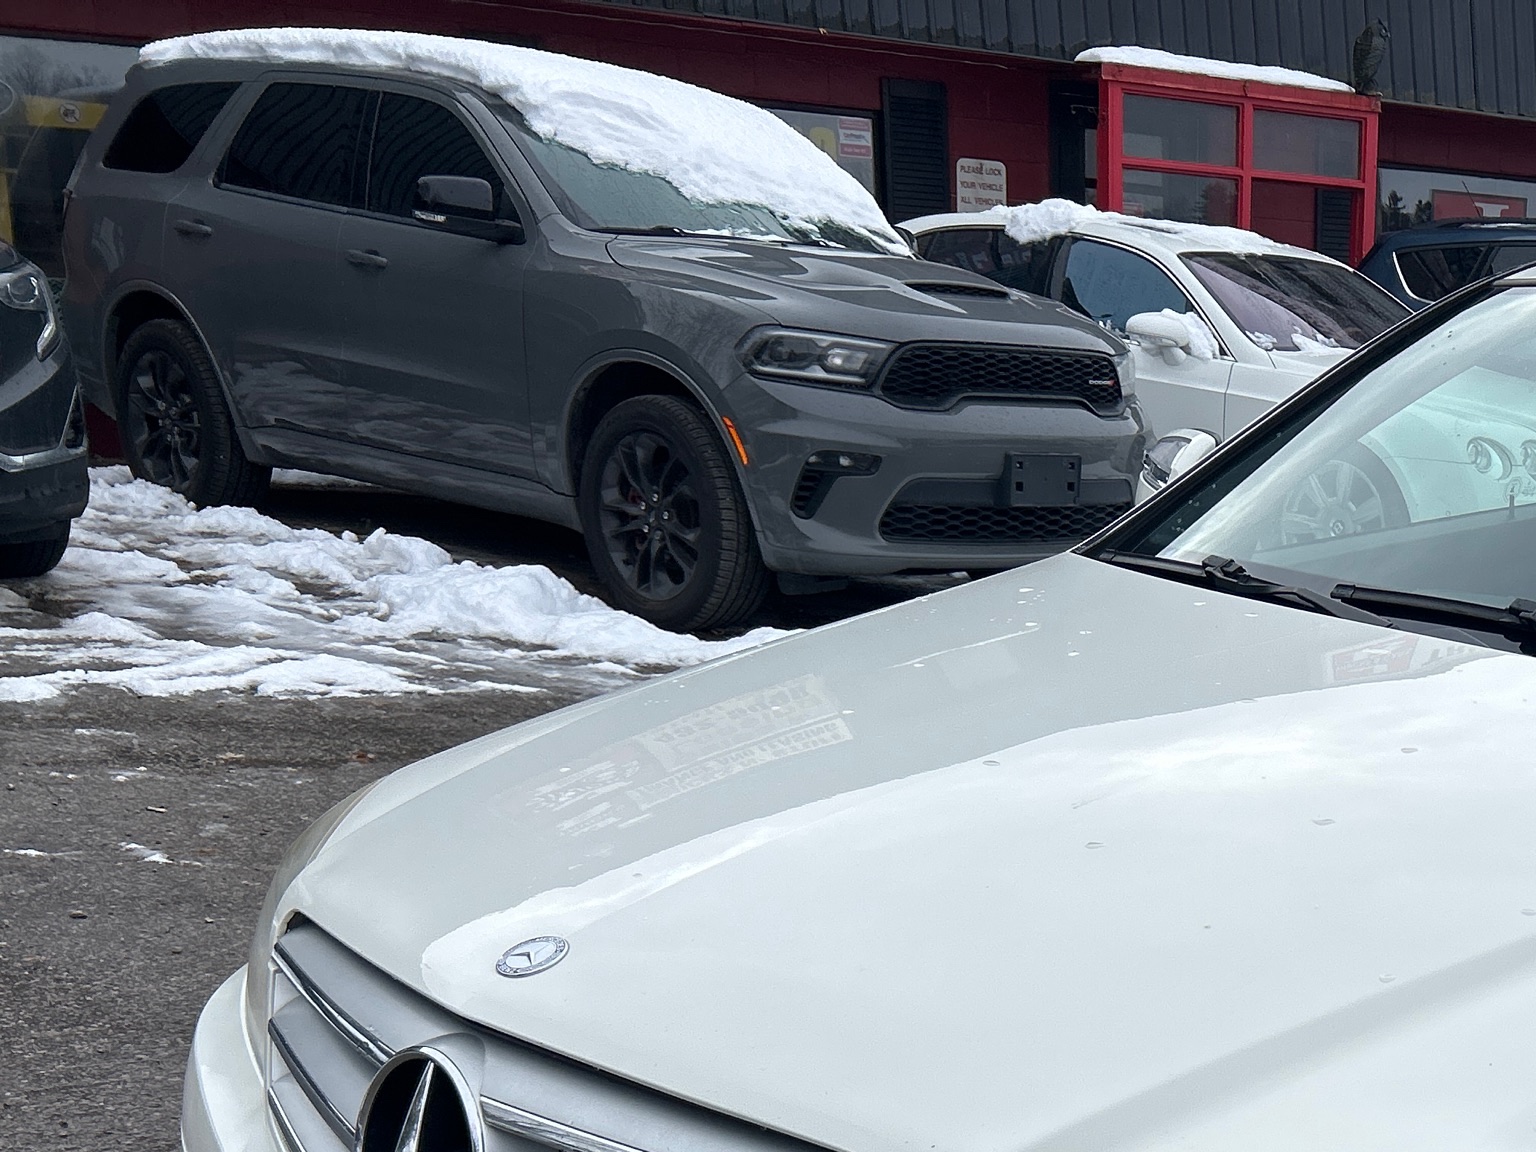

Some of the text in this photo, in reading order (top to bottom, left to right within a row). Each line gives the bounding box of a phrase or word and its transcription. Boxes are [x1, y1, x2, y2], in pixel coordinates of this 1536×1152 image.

[960, 165, 1002, 176] PLEASE LOCK
[959, 180, 1004, 192] YOUR VEHICLE
[960, 196, 972, 204] ALL
